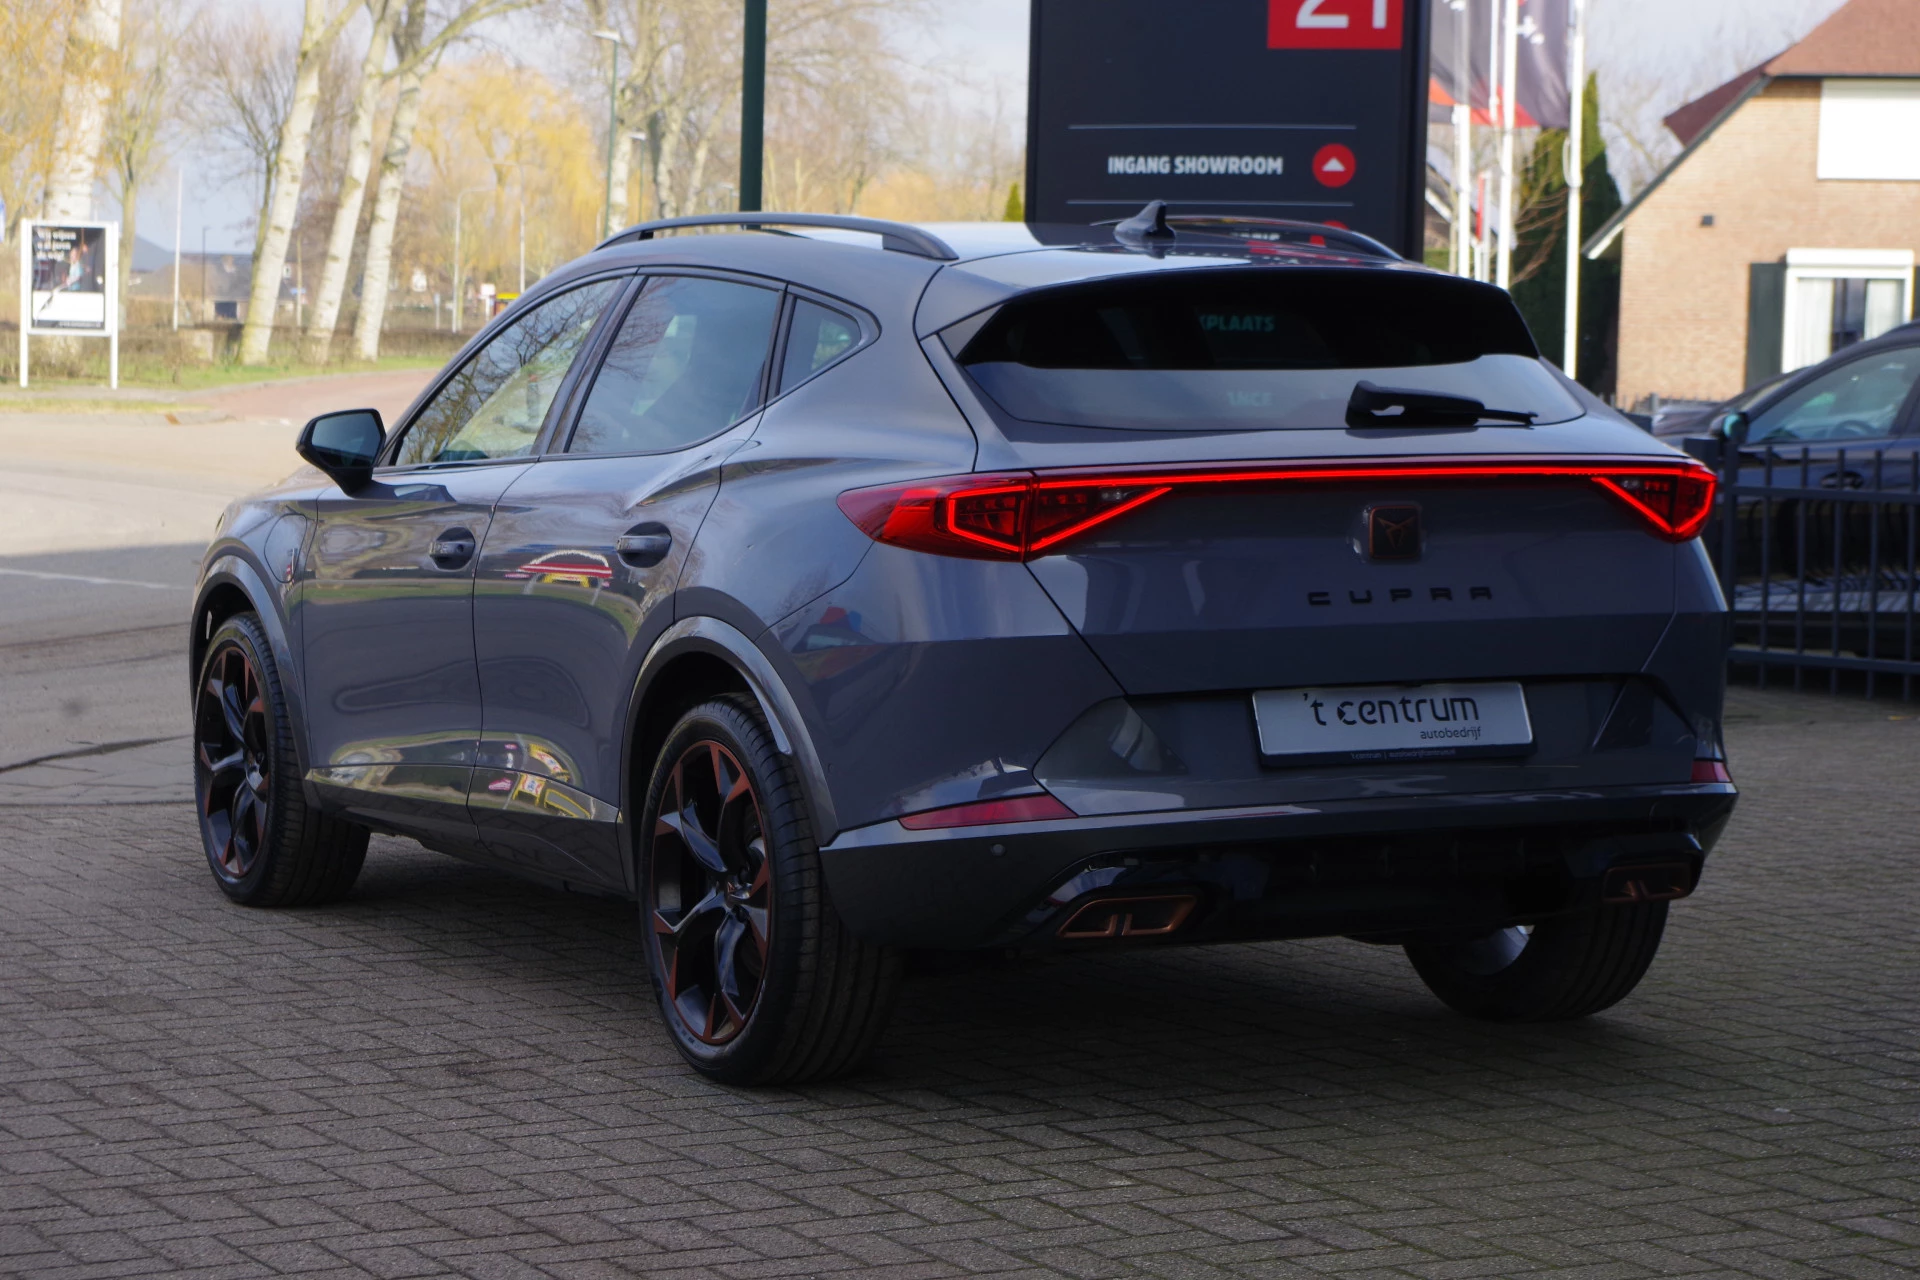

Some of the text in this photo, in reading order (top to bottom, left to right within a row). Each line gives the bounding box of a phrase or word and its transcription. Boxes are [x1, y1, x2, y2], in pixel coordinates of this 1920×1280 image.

[1107, 156, 1284, 175] INGANG SHOWROOM
[1307, 586, 1493, 606] CUPRA
[1337, 696, 1479, 725] centrum
[1420, 726, 1482, 741] autobedrijf
